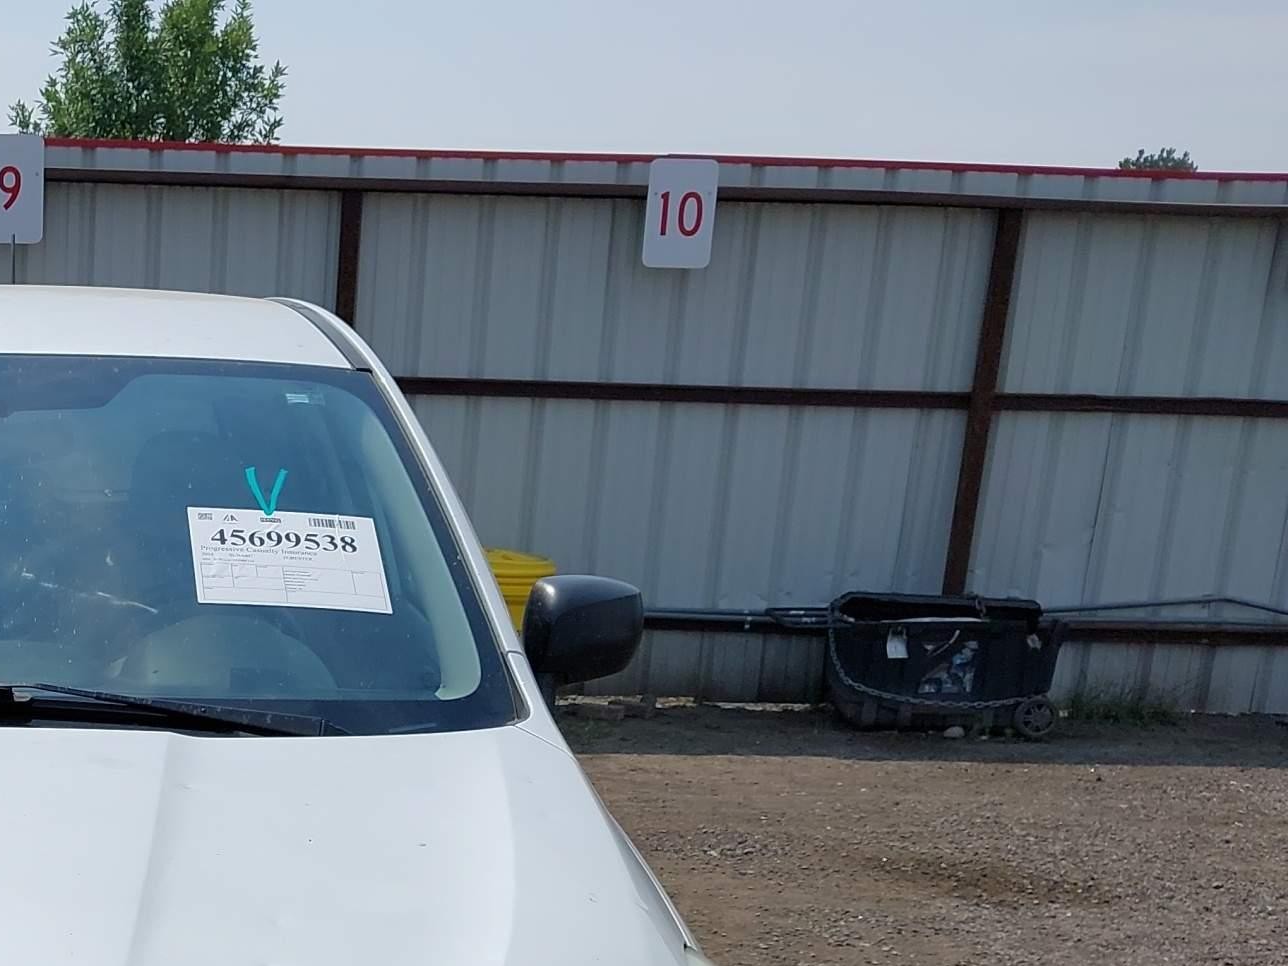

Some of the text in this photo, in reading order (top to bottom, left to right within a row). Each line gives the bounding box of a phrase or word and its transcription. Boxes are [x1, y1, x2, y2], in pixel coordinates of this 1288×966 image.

[659, 191, 703, 237] 10
[200, 544, 318, 557] Progressive Casualty Insurance
[211, 528, 358, 553] 45699538
